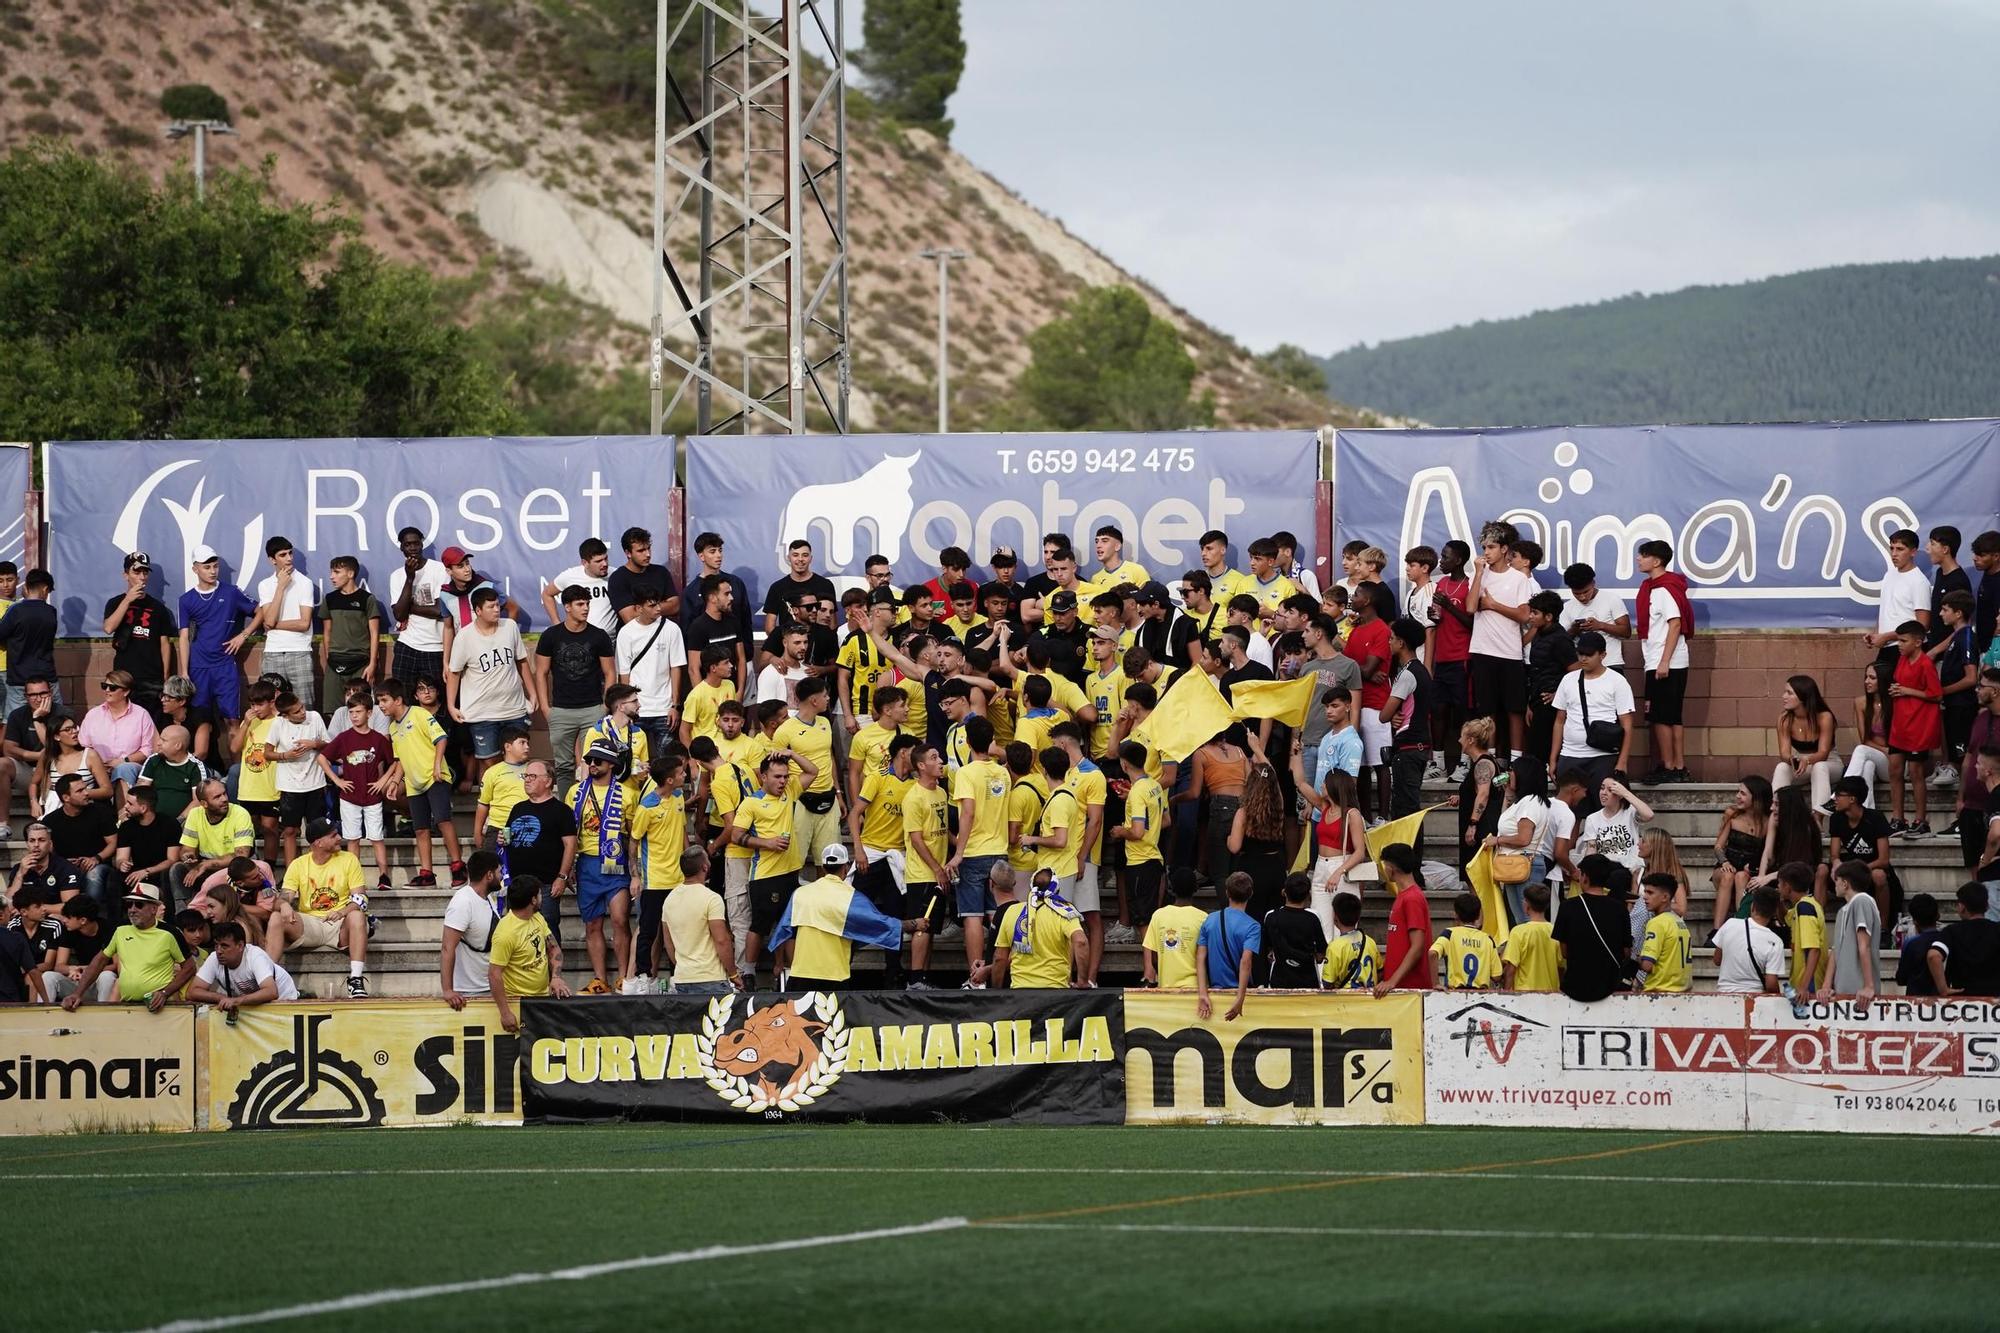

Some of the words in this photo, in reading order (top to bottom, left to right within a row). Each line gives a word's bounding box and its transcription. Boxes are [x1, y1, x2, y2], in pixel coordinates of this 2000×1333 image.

[996, 450, 1019, 474] T.
[1027, 449, 1078, 474] 659
[1084, 448, 1137, 473] 942
[1142, 448, 1195, 472] 475
[307, 469, 612, 551] Roset
[479, 647, 513, 672] GAP
[1462, 953, 1479, 987] 9
[531, 1033, 704, 1085] CURVA
[843, 1015, 1115, 1073] AMARILLA
[0, 1054, 180, 1100] simar
[1440, 1086, 1672, 1110] www.trivazquez.com
[1834, 1095, 1859, 1110] Tel
[1865, 1096, 1958, 1112] 938042046
[1978, 1098, 2000, 1113] IG
